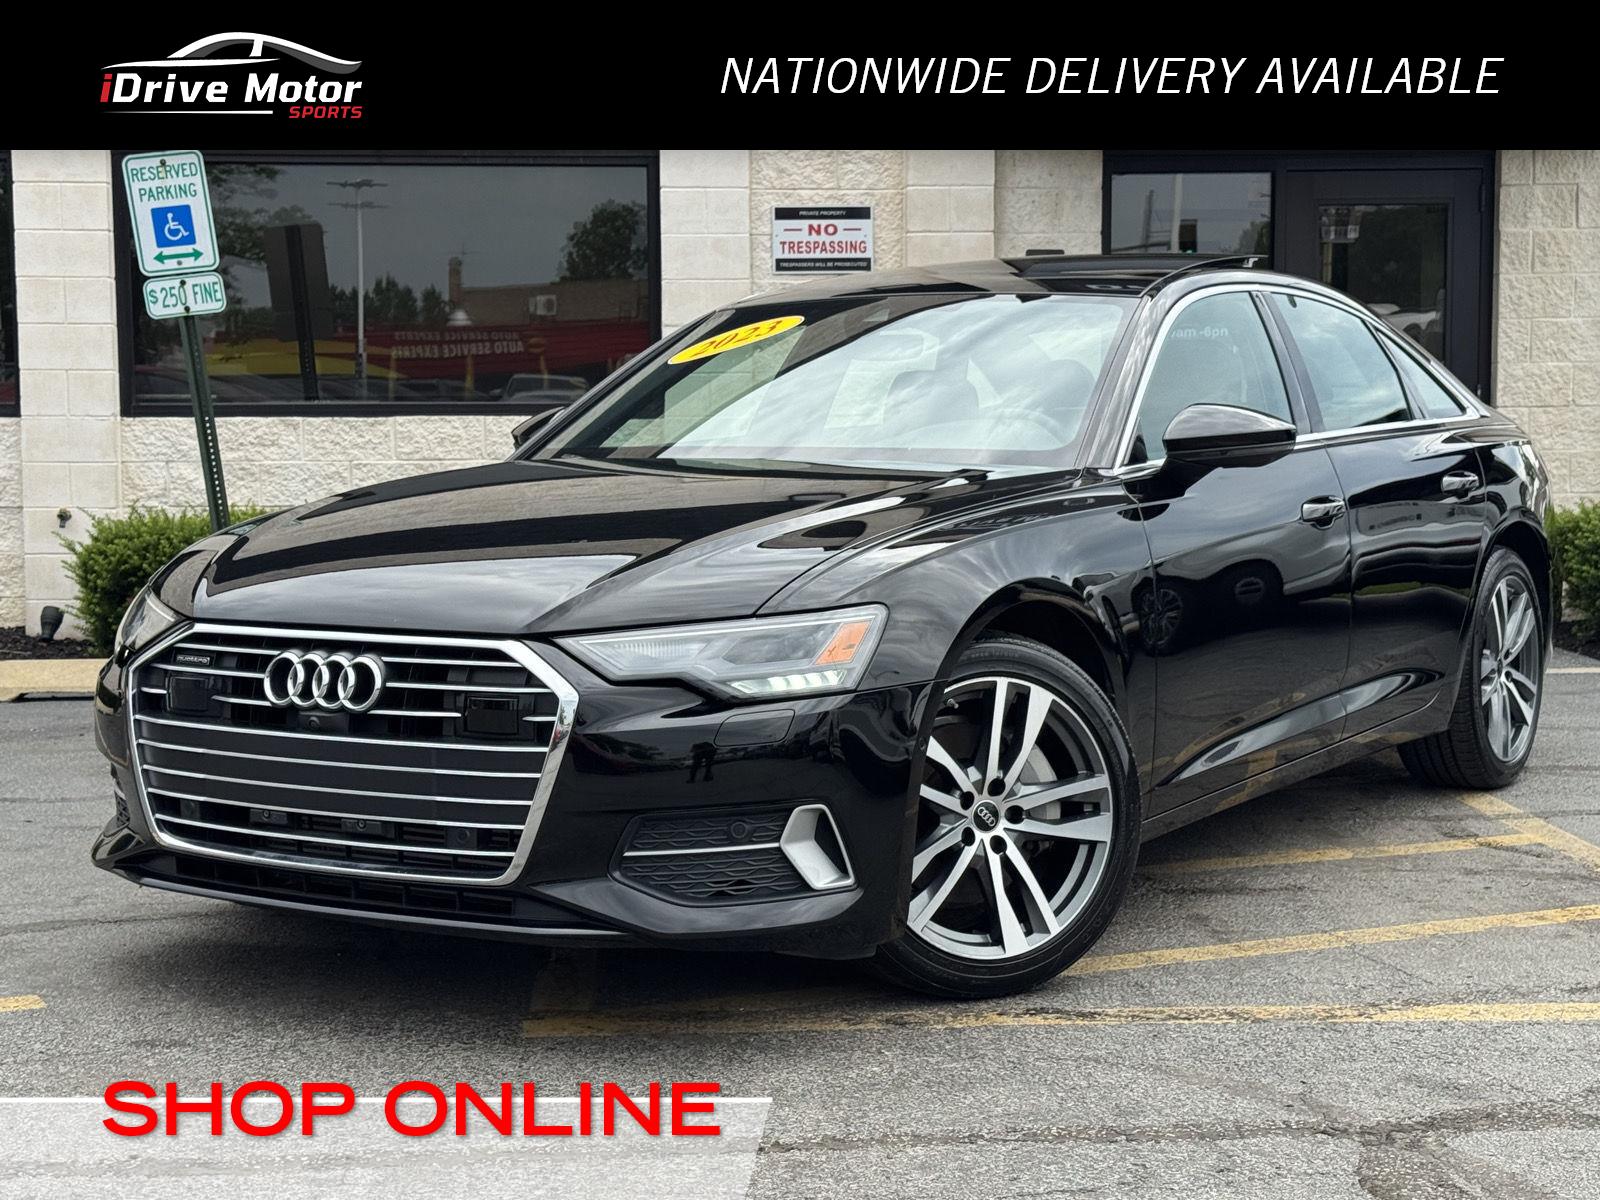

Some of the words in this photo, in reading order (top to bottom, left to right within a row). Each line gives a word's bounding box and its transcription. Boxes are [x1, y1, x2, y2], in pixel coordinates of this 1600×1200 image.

[130, 161, 199, 184] RESERVED
[138, 183, 198, 203] PARKING
[807, 223, 839, 237] NO
[779, 240, 868, 255] TRESPASSING
[148, 285, 187, 309] $250
[193, 281, 222, 305] FINE
[689, 319, 784, 358] 2023
